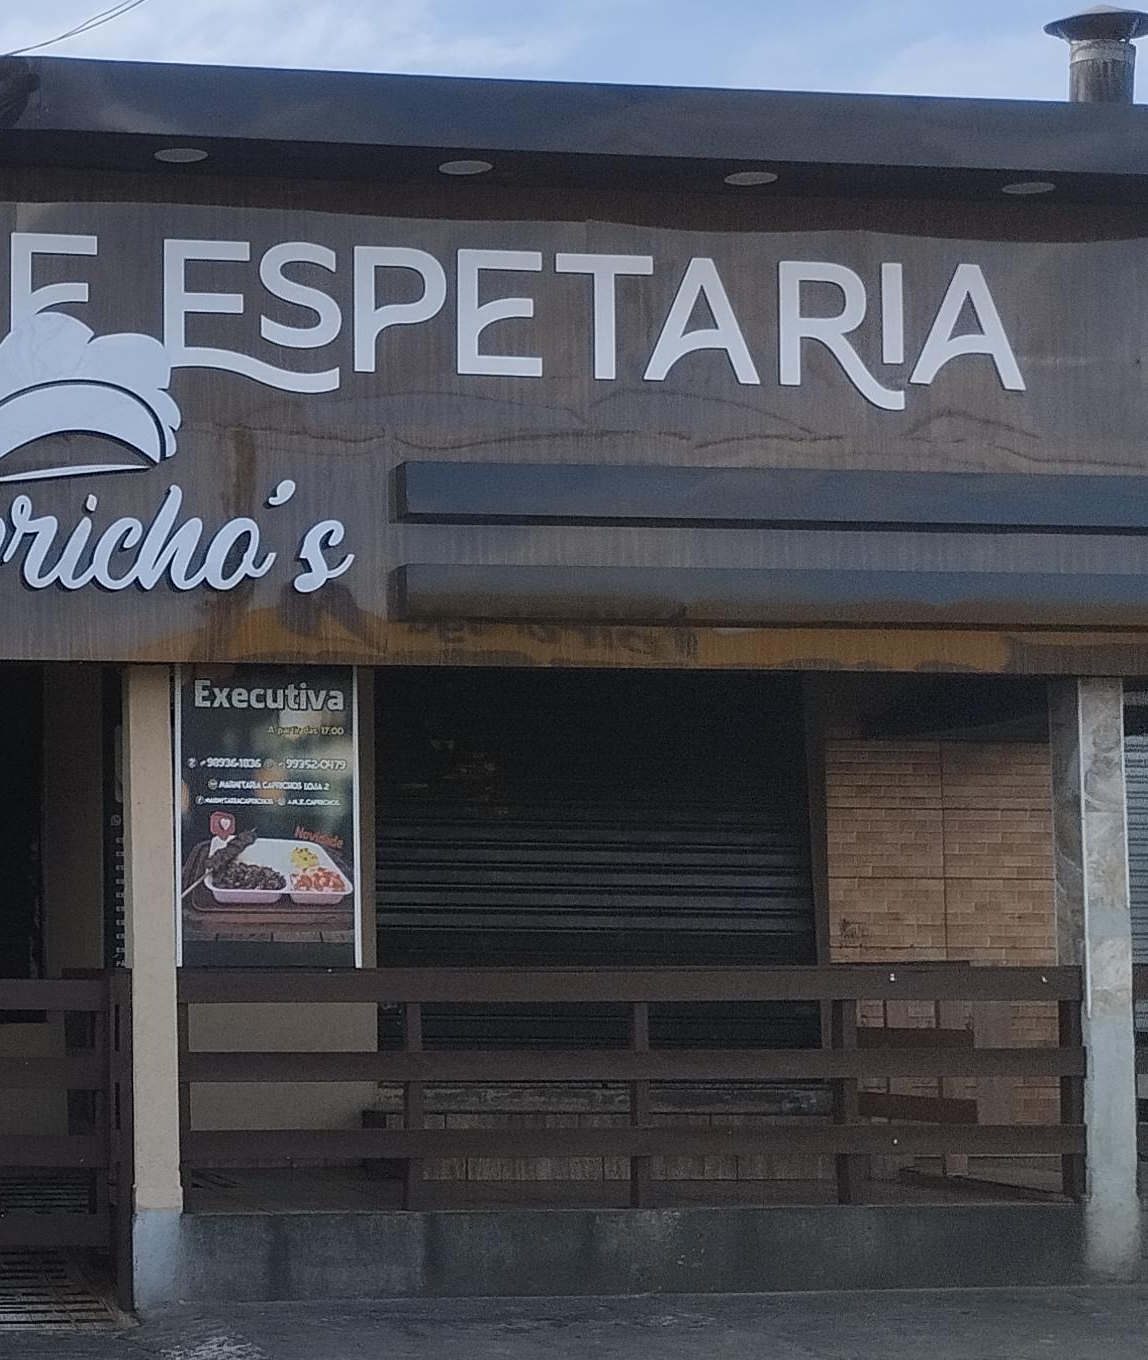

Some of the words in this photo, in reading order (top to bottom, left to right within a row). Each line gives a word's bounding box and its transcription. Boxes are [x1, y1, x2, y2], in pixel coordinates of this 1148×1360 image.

[163, 239, 1028, 411] ESPETARIA
[194, 679, 344, 711] Executiva
[267, 725, 275, 734] A
[277, 725, 302, 736] partir
[303, 725, 319, 735] das
[304, 782, 323, 791] LOJA
